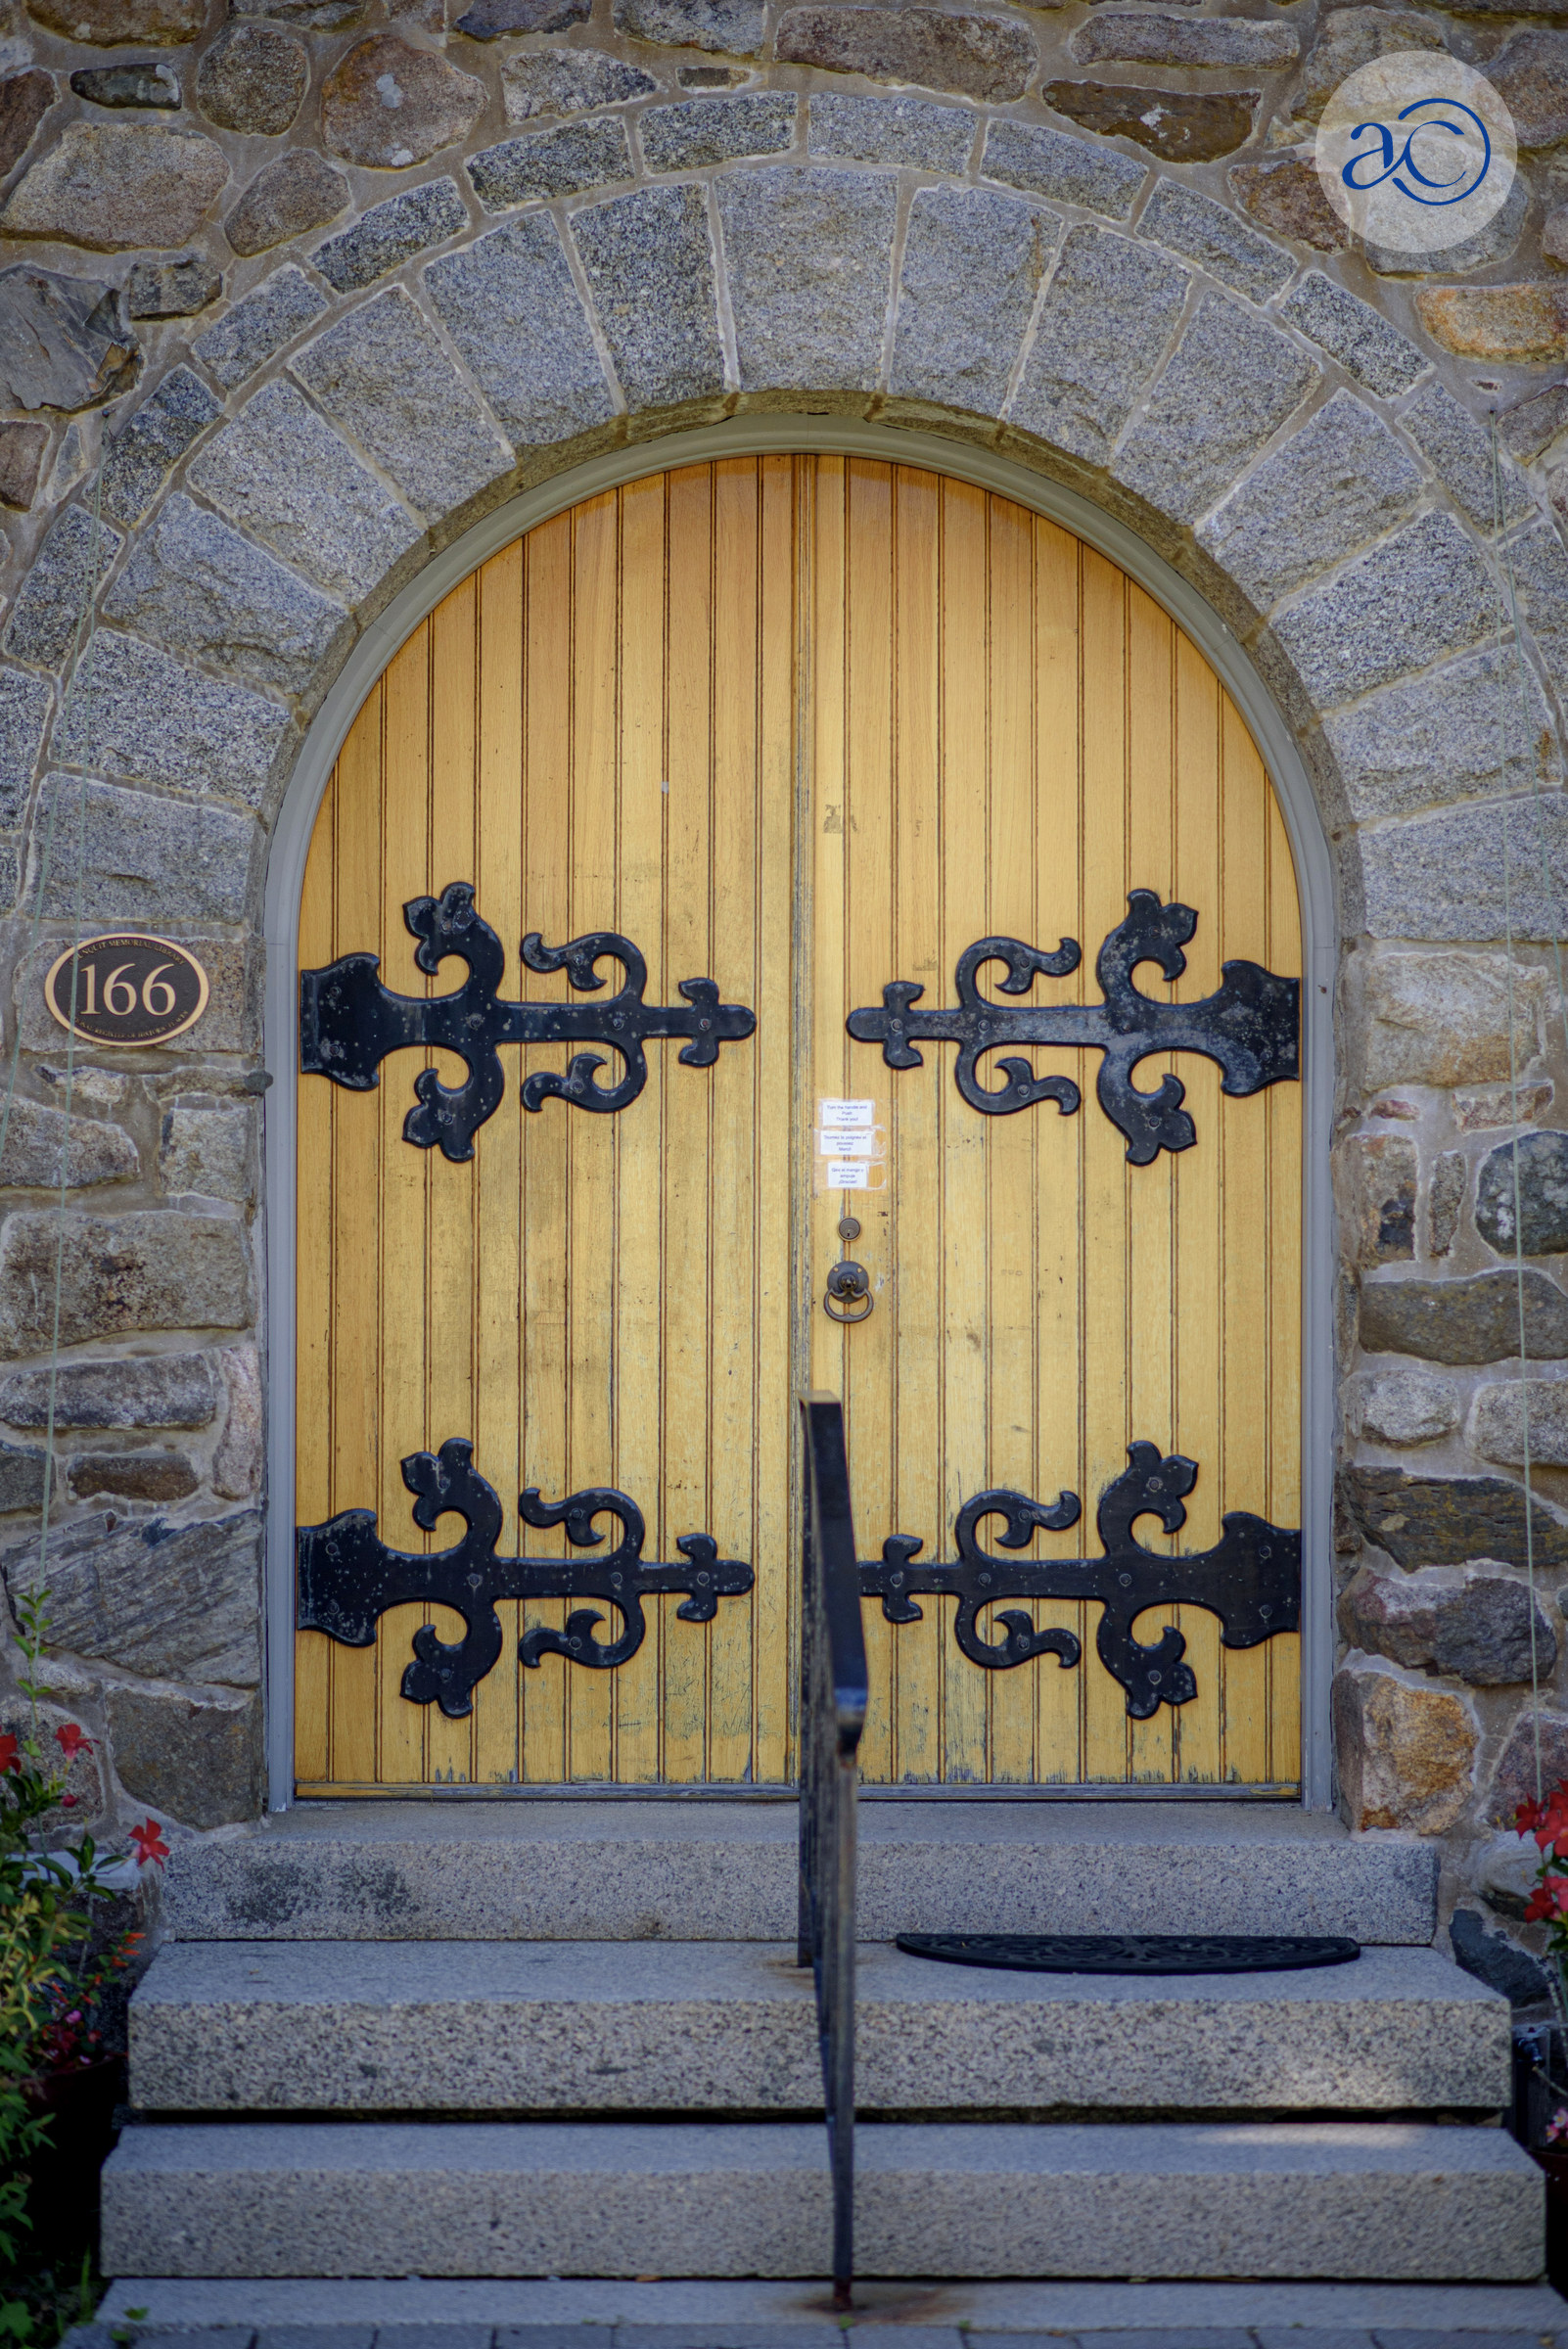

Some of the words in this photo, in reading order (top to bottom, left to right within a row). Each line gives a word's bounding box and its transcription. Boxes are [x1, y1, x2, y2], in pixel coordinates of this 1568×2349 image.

[69, 942, 106, 966] UNQUIT
[109, 939, 153, 949] MEMORIAL
[154, 943, 186, 965] LIBRARY
[79, 963, 176, 1016] 166
